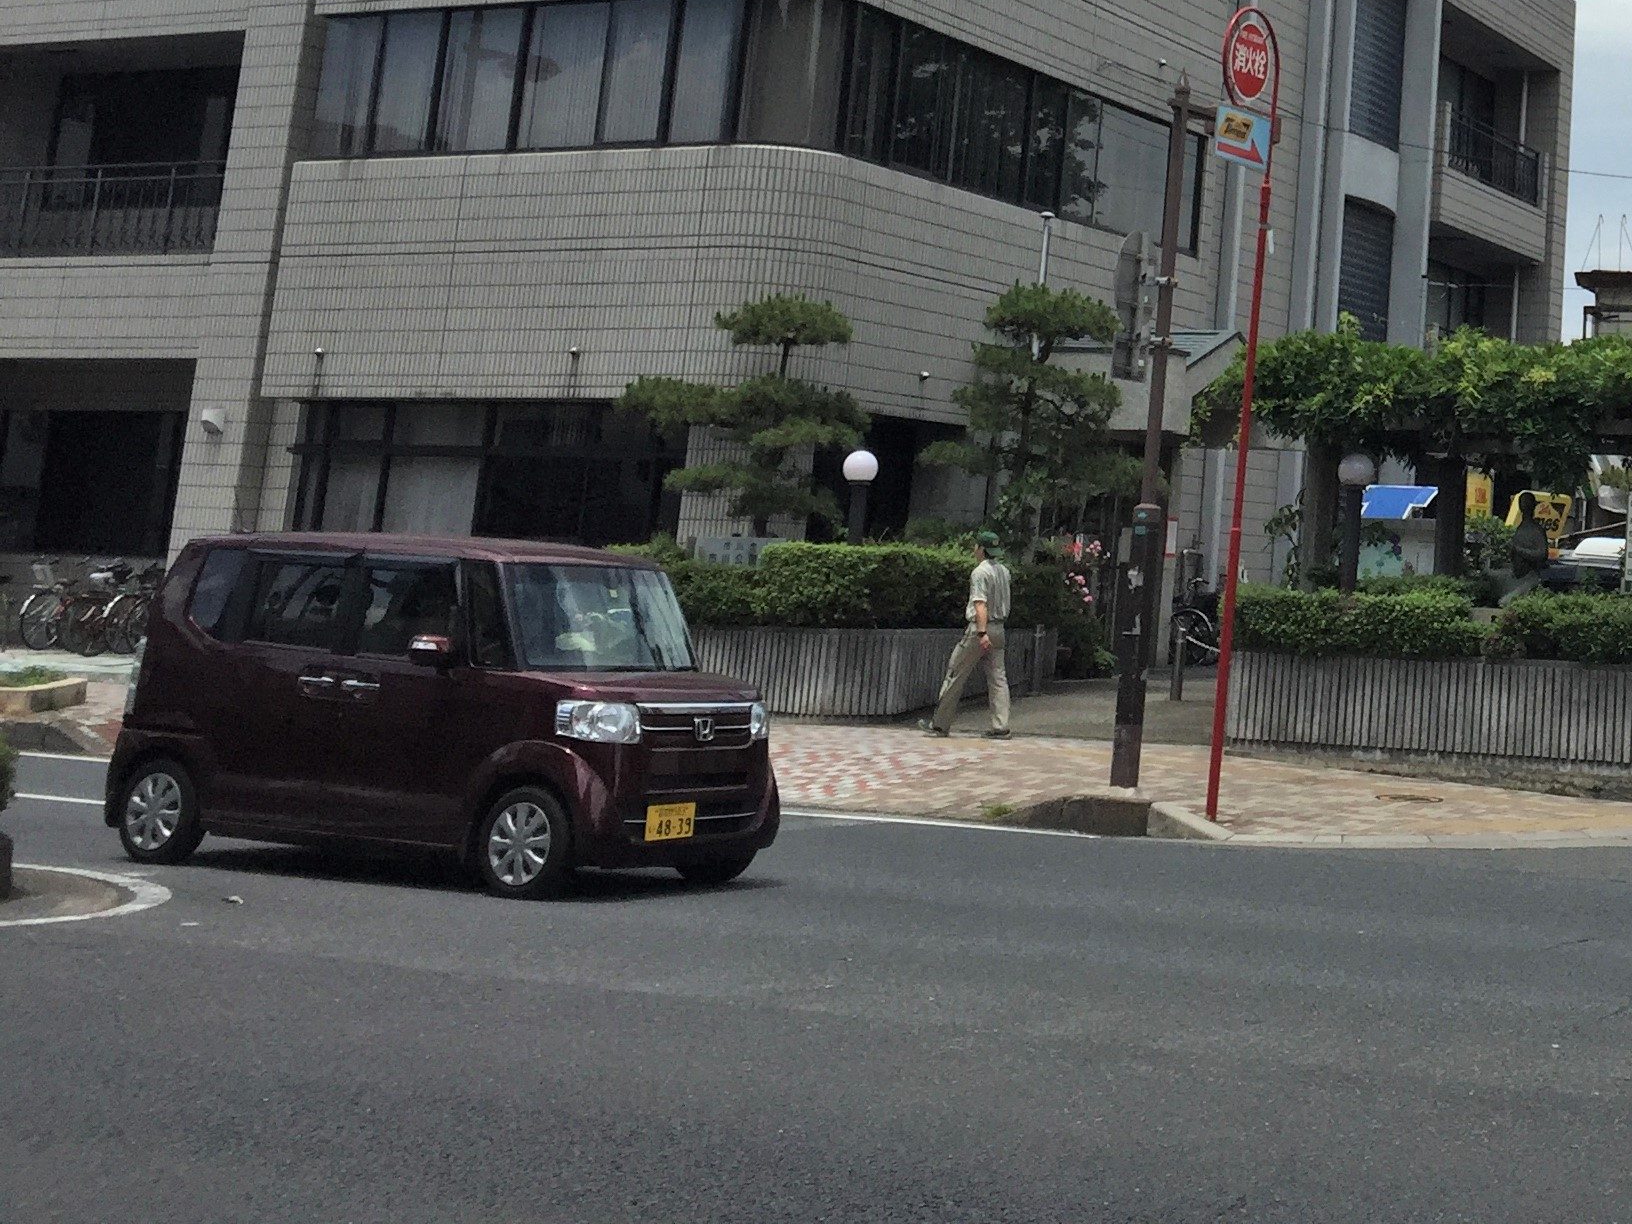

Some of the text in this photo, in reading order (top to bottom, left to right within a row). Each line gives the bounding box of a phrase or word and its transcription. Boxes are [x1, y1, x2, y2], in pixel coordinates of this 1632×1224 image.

[1234, 43, 1267, 80] 消火栓
[656, 818, 692, 837] 48-39
